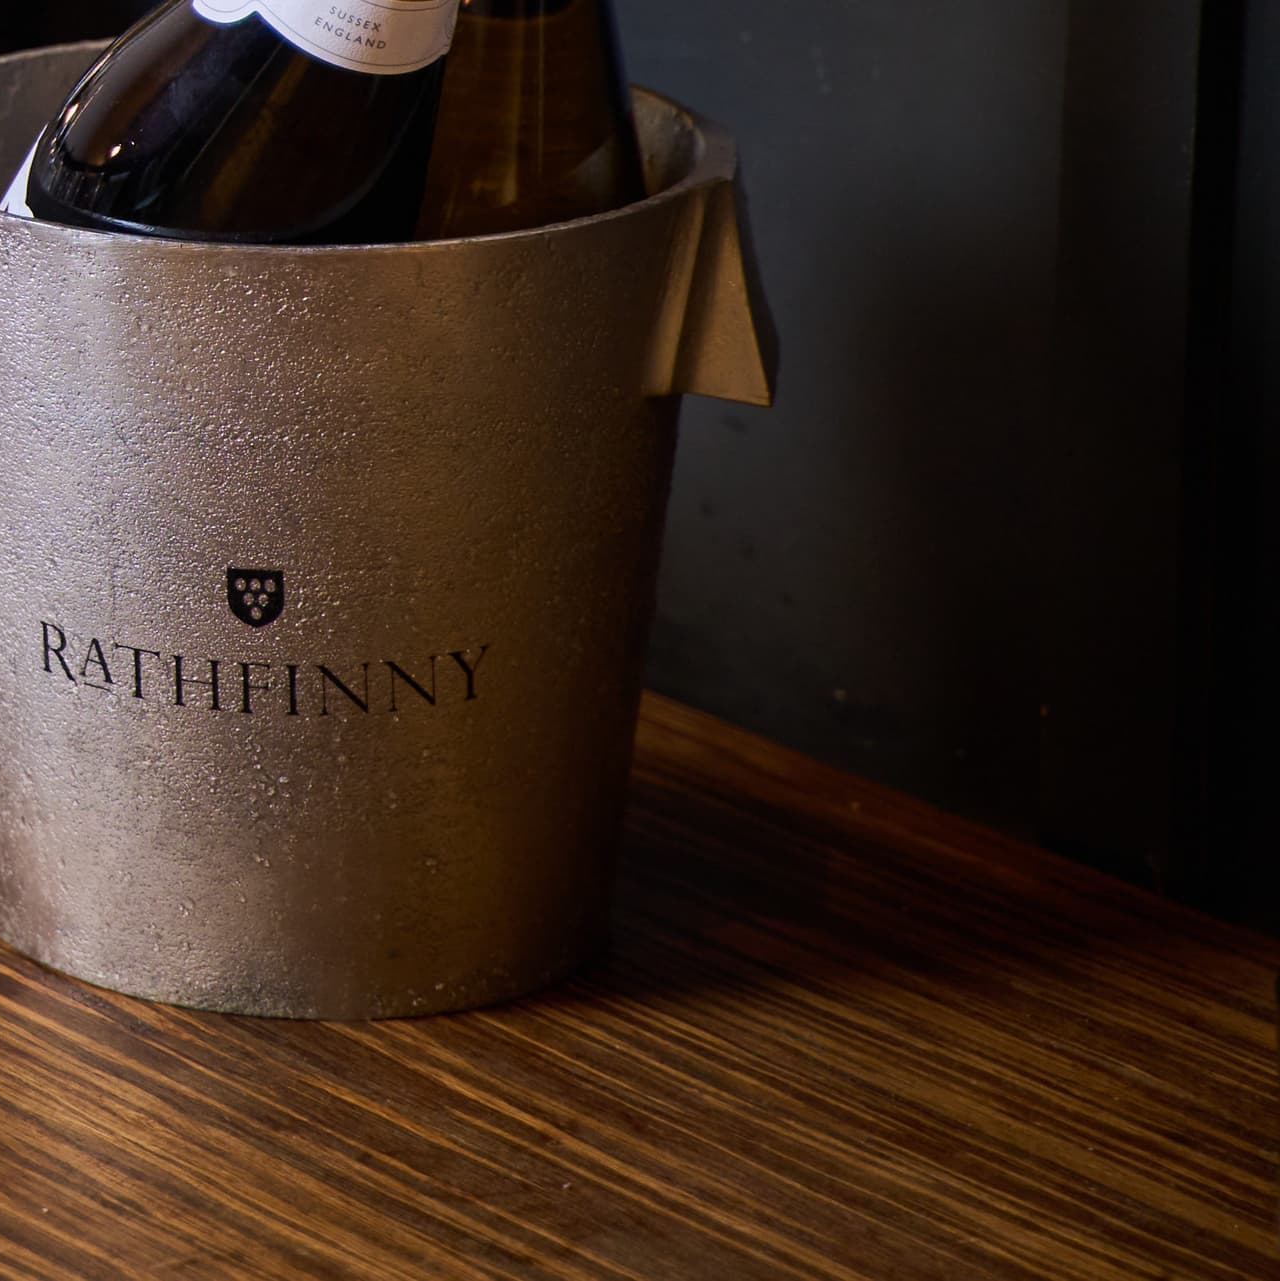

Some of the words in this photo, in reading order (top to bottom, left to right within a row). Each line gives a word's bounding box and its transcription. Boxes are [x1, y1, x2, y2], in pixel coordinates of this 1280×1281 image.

[314, 16, 386, 49] ENGLAND
[329, 6, 381, 32] SUSSEX
[40, 621, 490, 716] RATHFINNY
